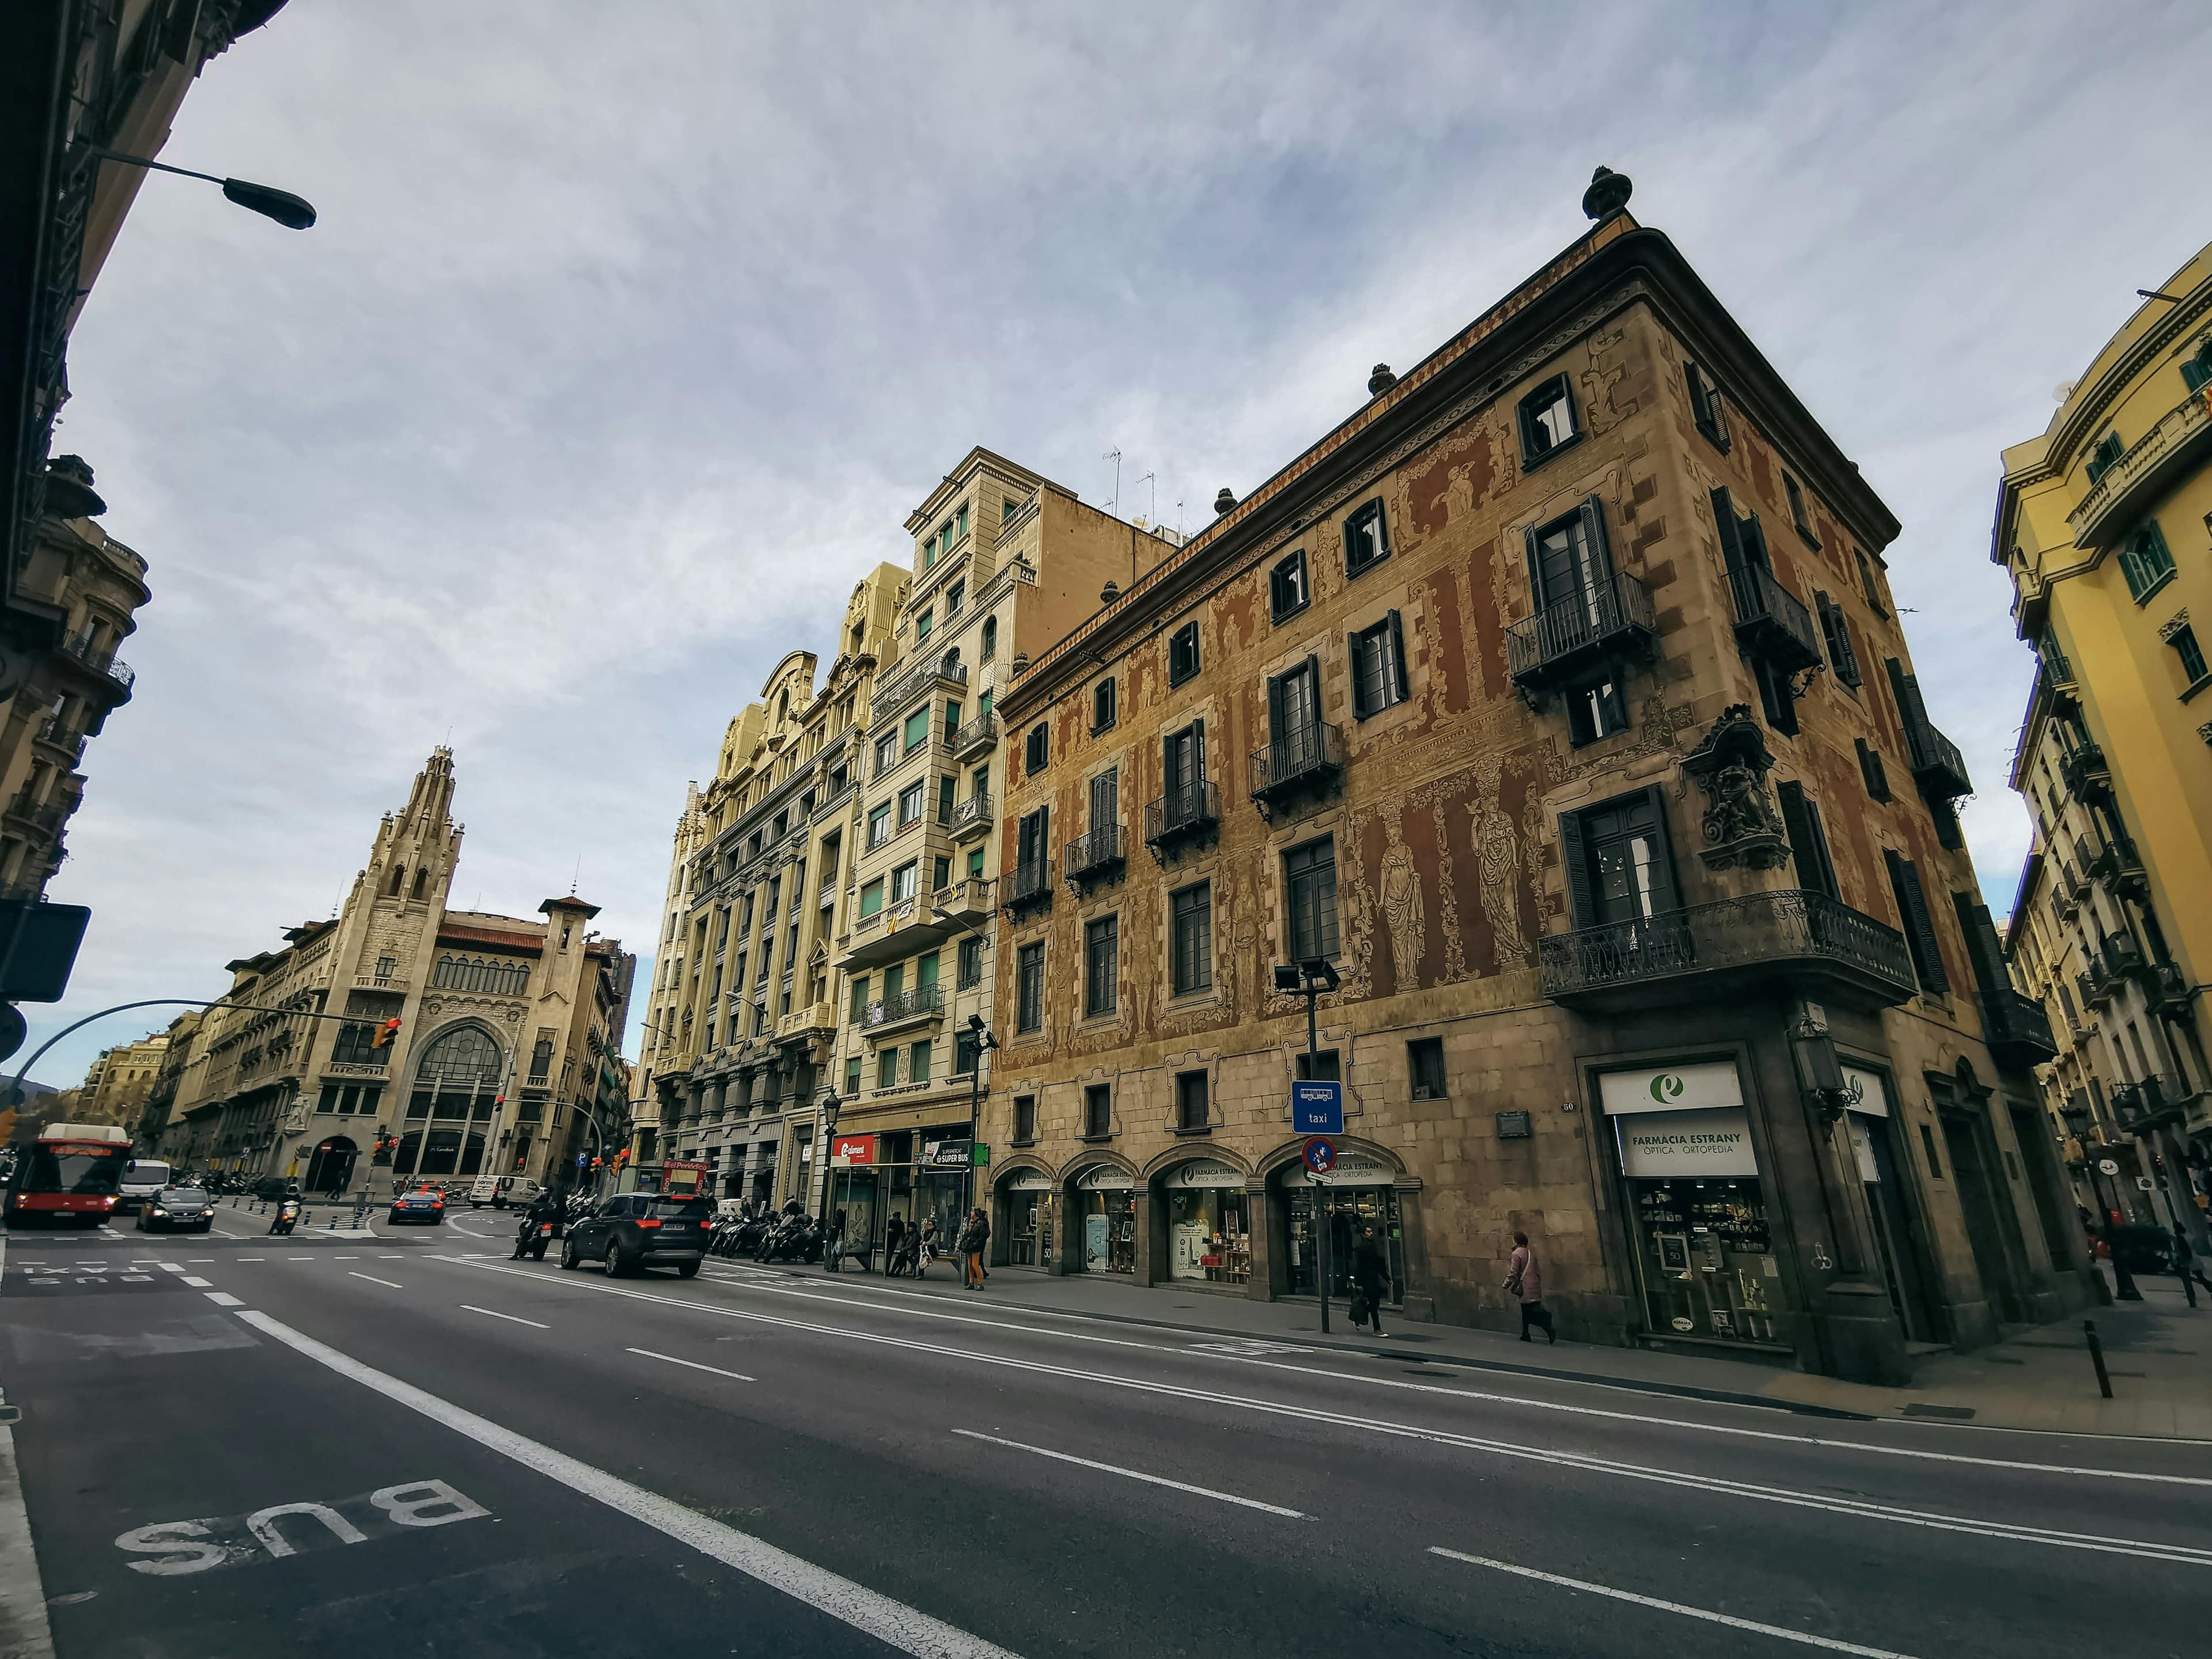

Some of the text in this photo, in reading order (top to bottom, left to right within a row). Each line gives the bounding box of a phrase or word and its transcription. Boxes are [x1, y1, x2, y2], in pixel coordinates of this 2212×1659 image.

[1563, 1103, 1574, 1111] 50
[1309, 1113, 1327, 1123] taxi
[1633, 1133, 1741, 1146] FARMÀCIA ESTRANY
[1643, 1145, 1675, 1155] ÒPTICA
[578, 1153, 586, 1161] P
[941, 1153, 968, 1163] SUPER BUS
[676, 1162, 707, 1171] Periódico
[1669, 1251, 1681, 1260] 50
[27, 1275, 155, 1285] BUS
[115, 1478, 493, 1576] BUS
